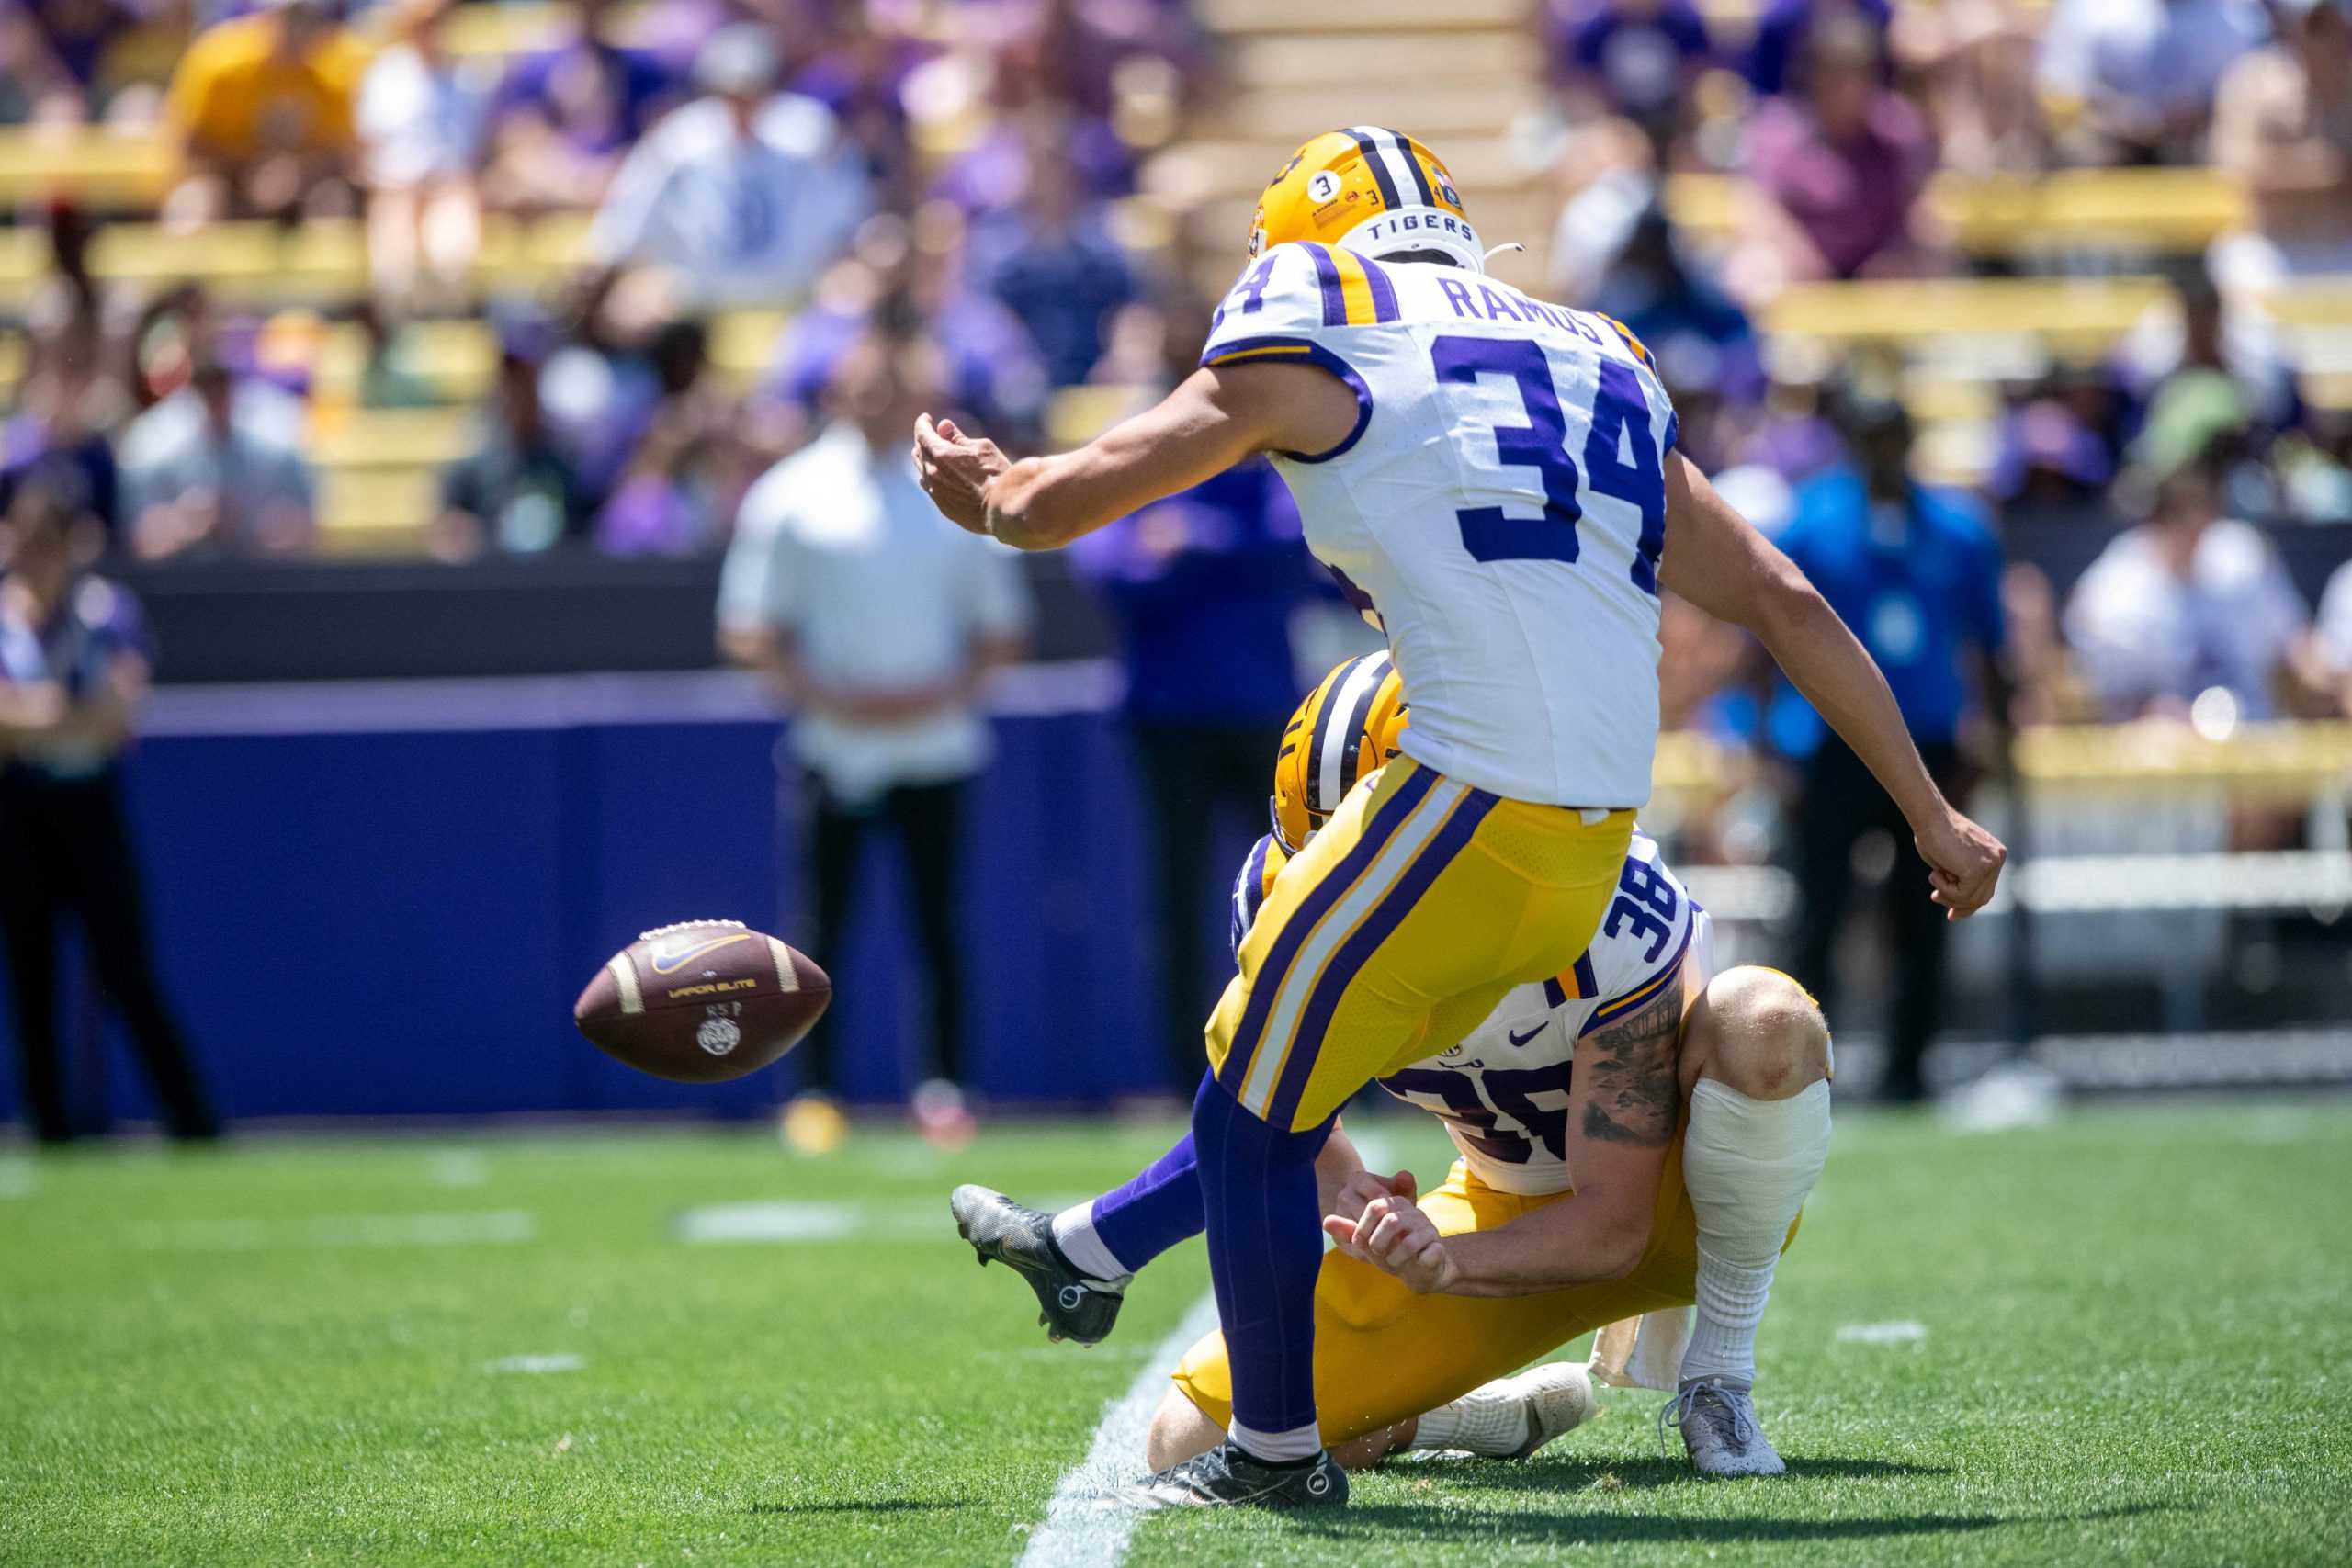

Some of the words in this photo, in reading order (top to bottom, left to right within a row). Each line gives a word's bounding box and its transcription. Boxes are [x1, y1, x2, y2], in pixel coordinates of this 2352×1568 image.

[1316, 175, 1331, 197] 3
[1365, 189, 1380, 206] 3
[1366, 214, 1474, 241] TIGERS
[1436, 277, 1605, 346] RAMOS
[1430, 335, 1667, 595] 34
[1603, 854, 1678, 964] 38
[717, 978, 757, 991] ELITE
